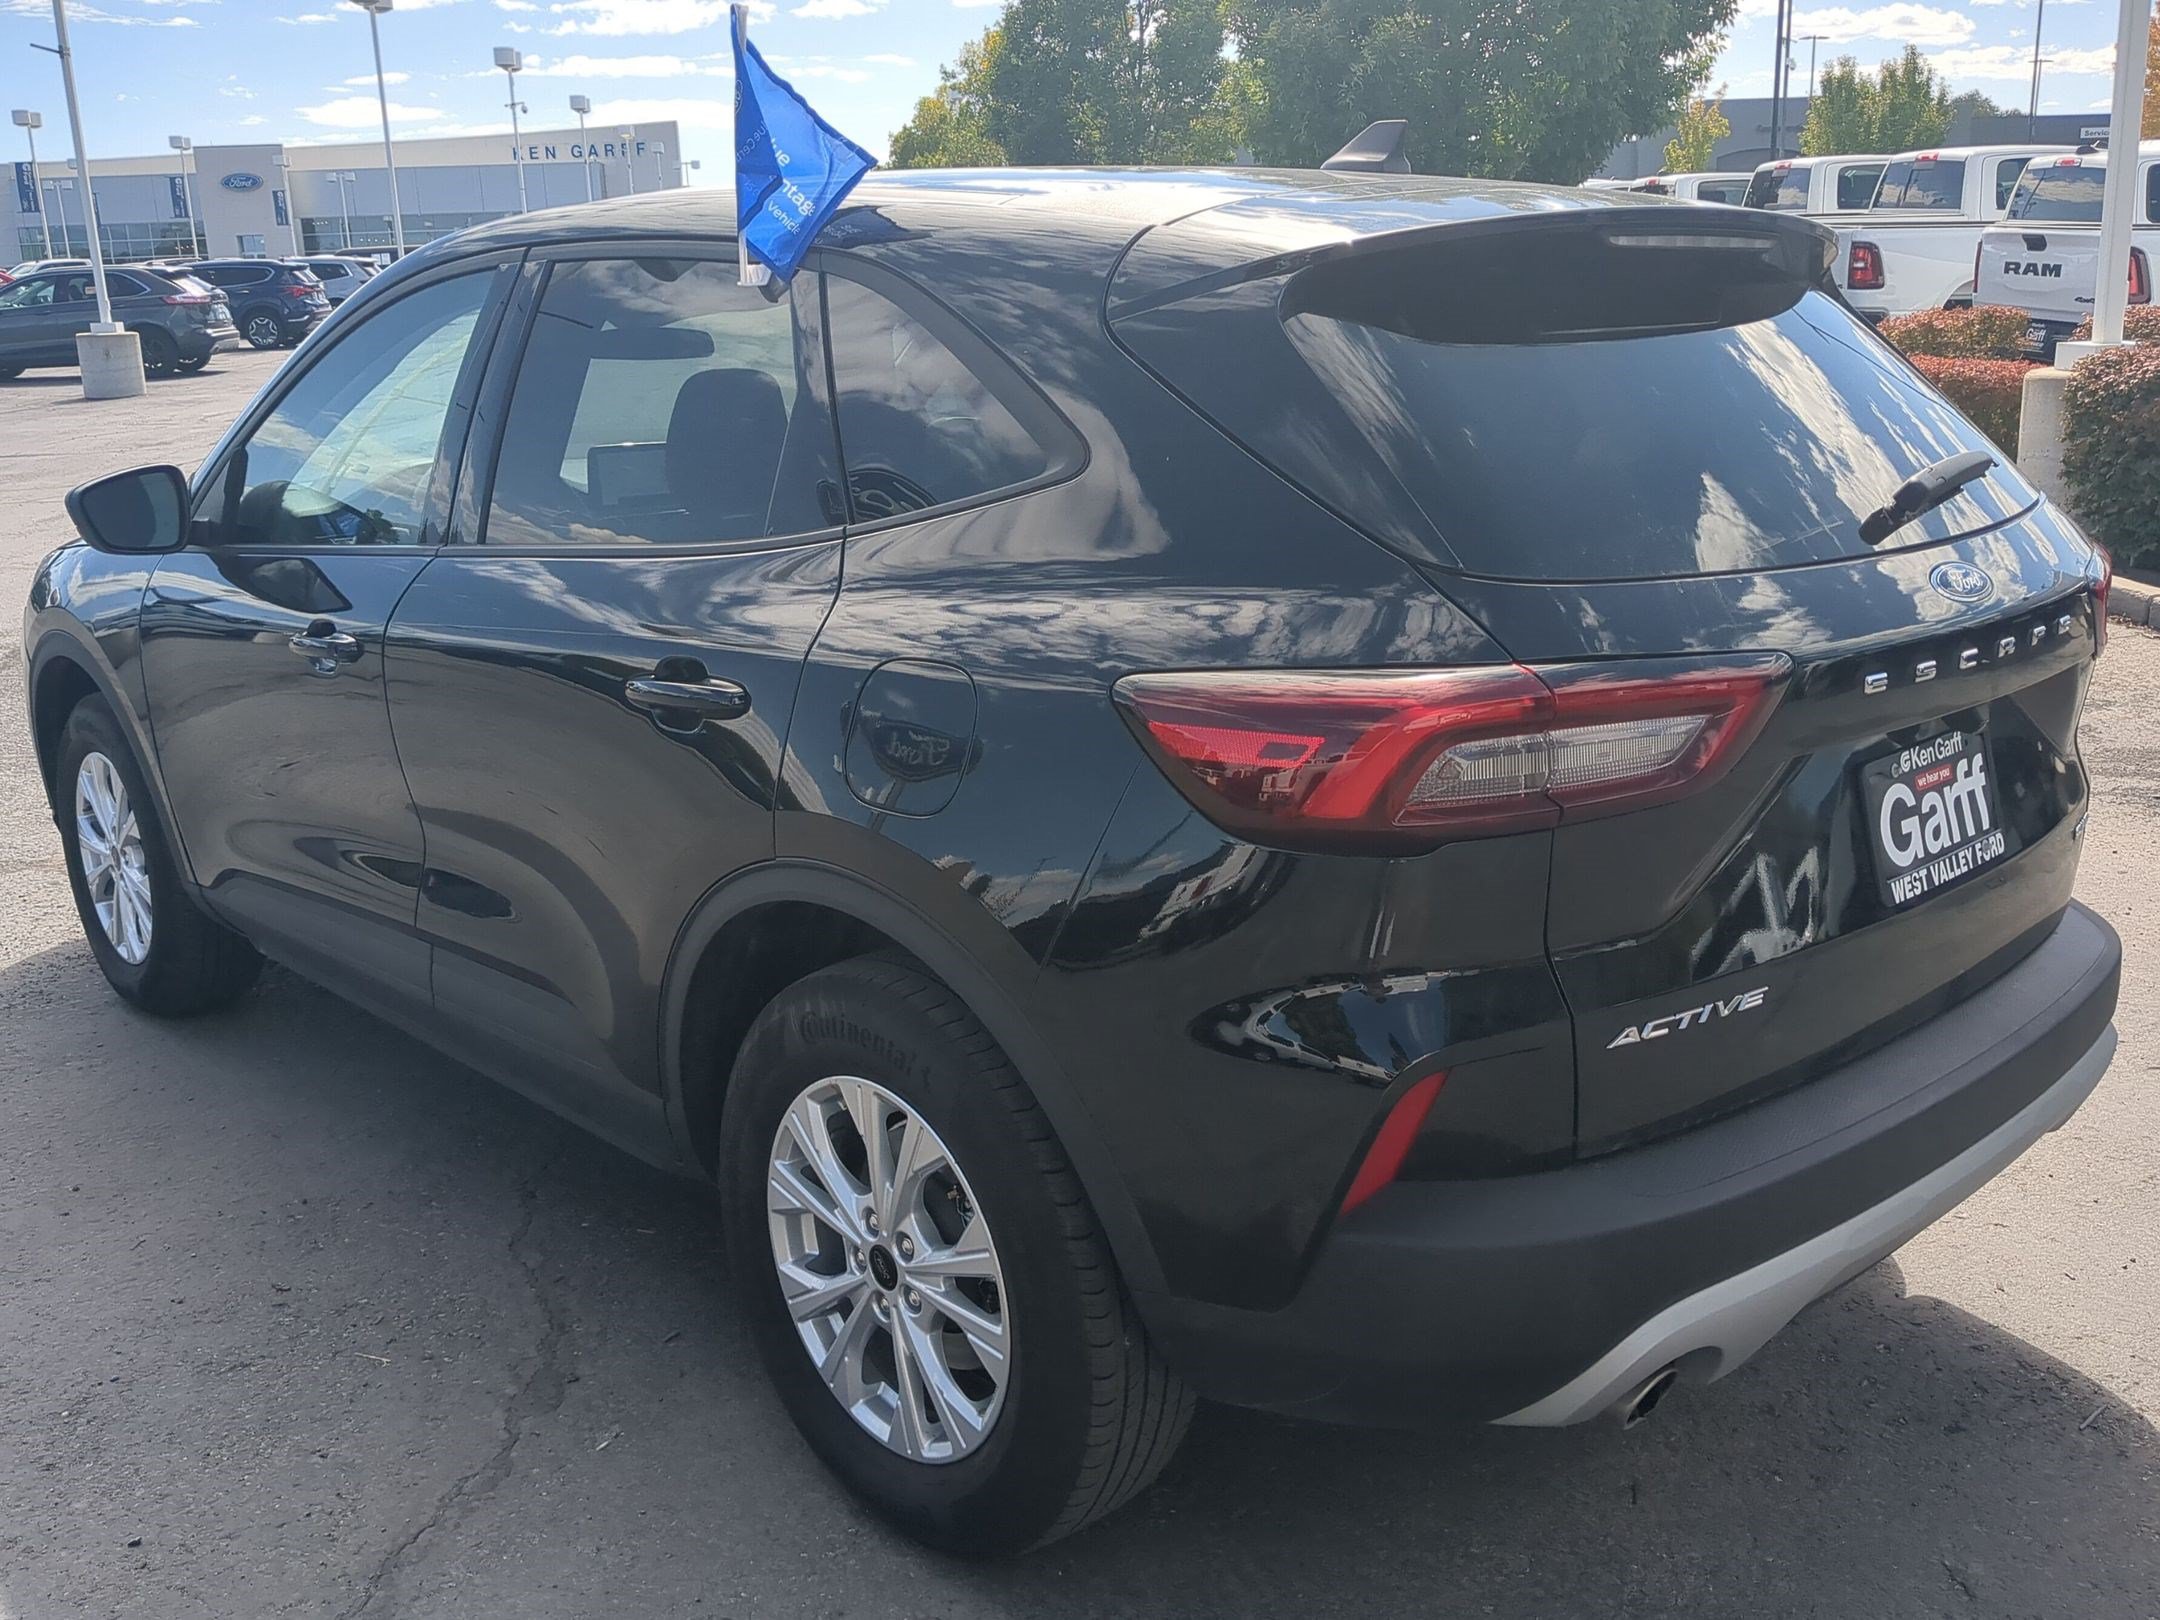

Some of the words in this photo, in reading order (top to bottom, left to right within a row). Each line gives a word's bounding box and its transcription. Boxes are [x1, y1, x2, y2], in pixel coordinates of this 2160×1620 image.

[2003, 261, 2063, 278] RAM
[1946, 568, 1984, 593] Ford
[1863, 615, 2072, 695] ESCAPE
[1910, 745, 1936, 770] Ken
[1934, 731, 1963, 760] Garff
[1917, 776, 1927, 787] we
[1925, 770, 1939, 783] hear
[1939, 767, 1951, 780] you
[1880, 753, 1990, 867] Garff
[1891, 869, 1929, 904] WEST
[1929, 852, 1974, 887] VALLEY
[1976, 833, 2005, 865] FORD
[1605, 985, 1769, 1049] ACTIVE
